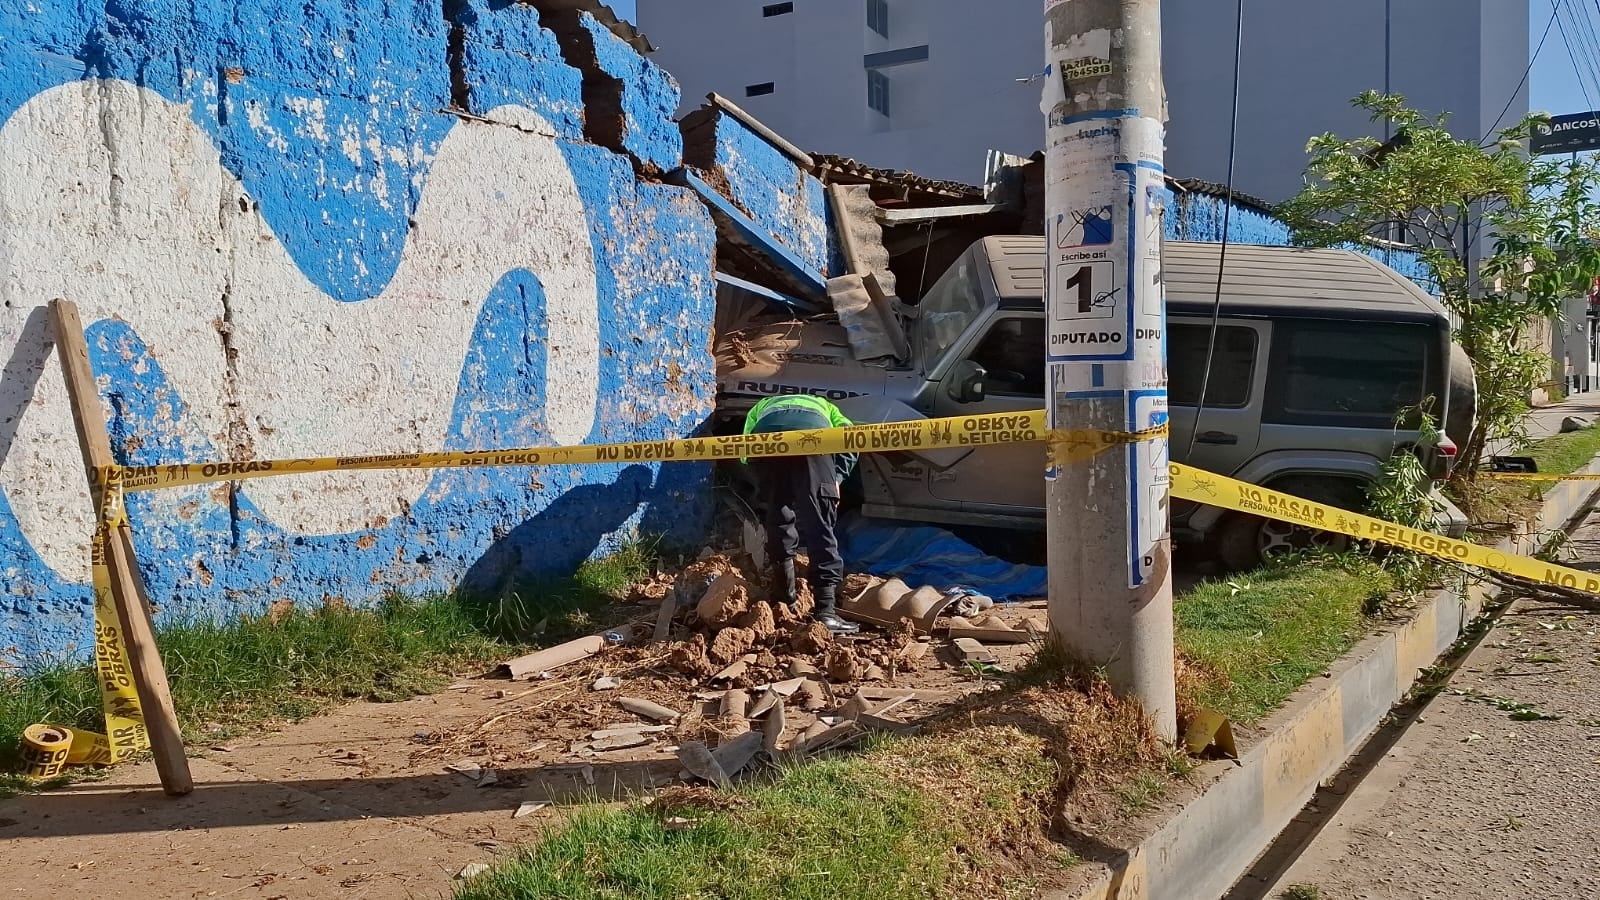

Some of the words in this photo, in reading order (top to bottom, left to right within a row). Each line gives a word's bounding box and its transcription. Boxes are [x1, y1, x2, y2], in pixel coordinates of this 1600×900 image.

[1061, 252, 1091, 261] Escribe
[1066, 266, 1092, 314] 1
[1052, 332, 1122, 345] DIPUTADO
[1136, 328, 1161, 340] DIPU
[202, 460, 273, 477] OBRAS
[1238, 485, 1263, 503] NO
[1268, 494, 1325, 521] PASAR
[1239, 498, 1278, 514] PERSONAS
[1369, 521, 1469, 559] PELIGRO
[1545, 568, 1577, 588] NO
[95, 619, 119, 692] PELIGRO
[104, 626, 130, 687] OBRAS
